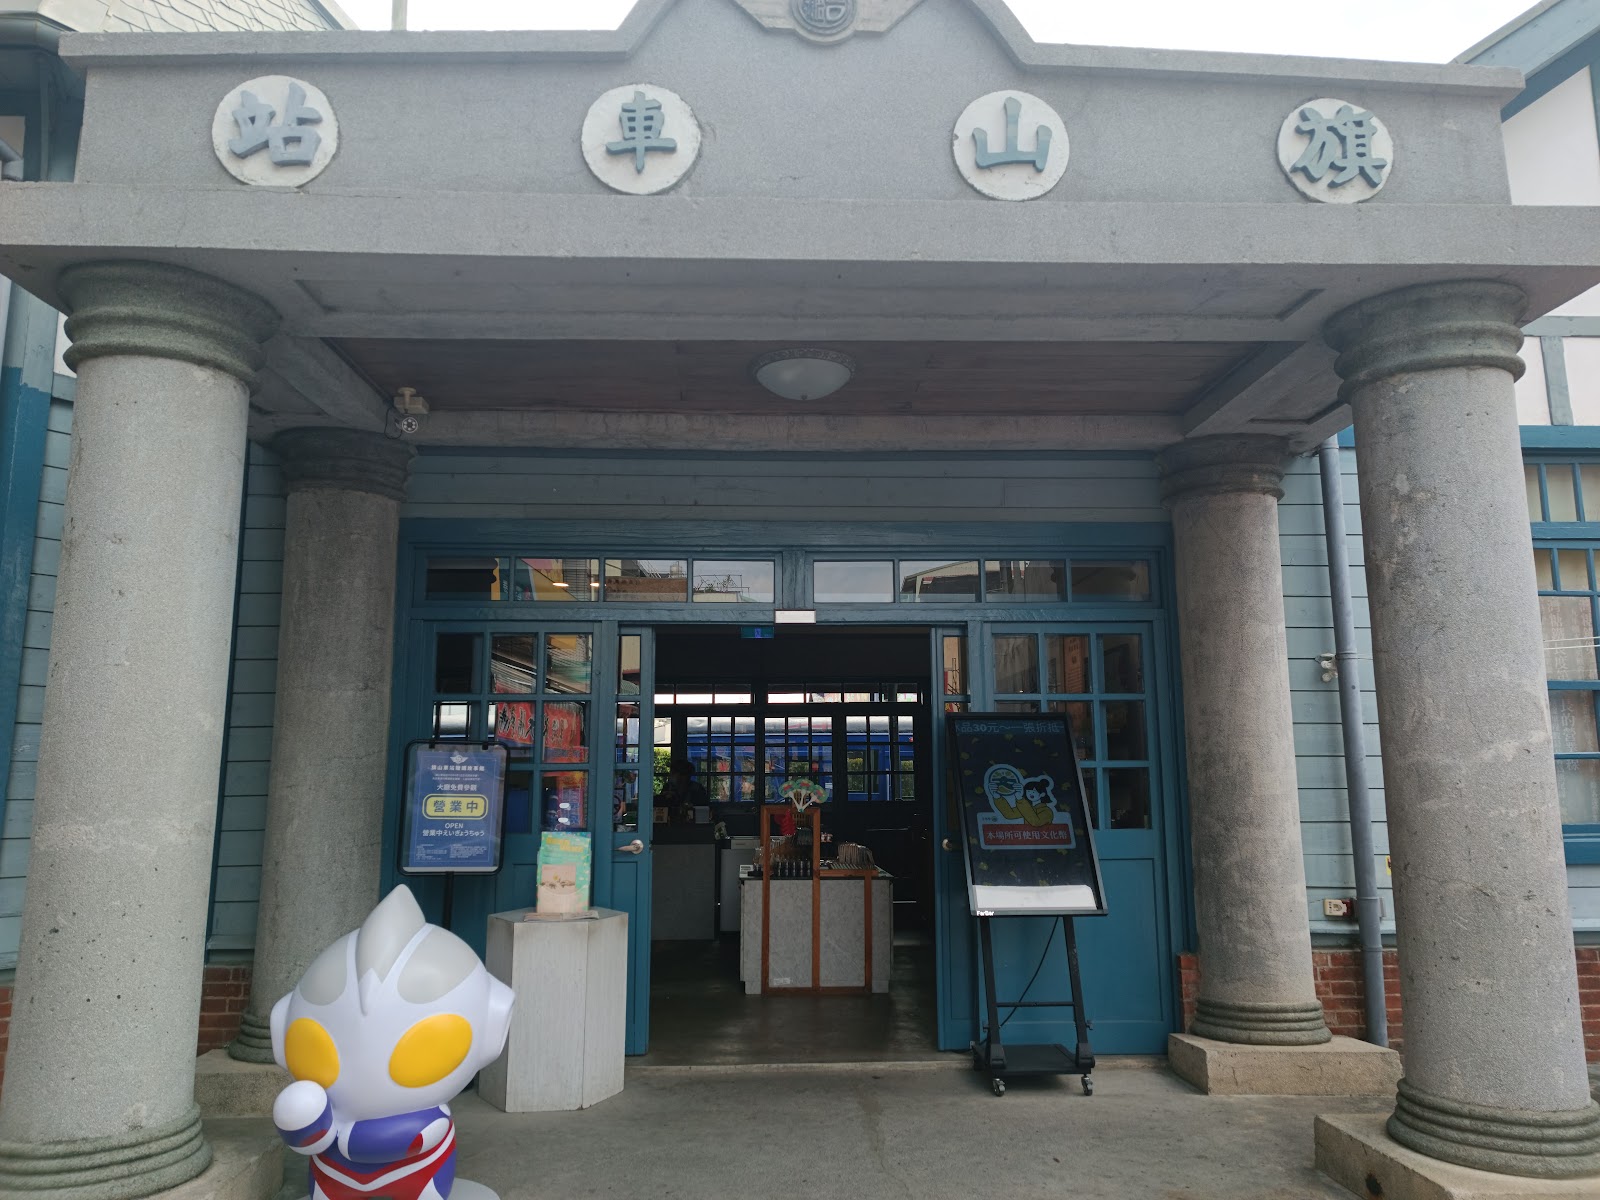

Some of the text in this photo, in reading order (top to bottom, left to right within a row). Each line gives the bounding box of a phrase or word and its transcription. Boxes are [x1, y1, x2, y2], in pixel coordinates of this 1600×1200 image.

[433, 799, 478, 813] 營業中
[987, 830, 1067, 840] 本場所可使用文化幣
